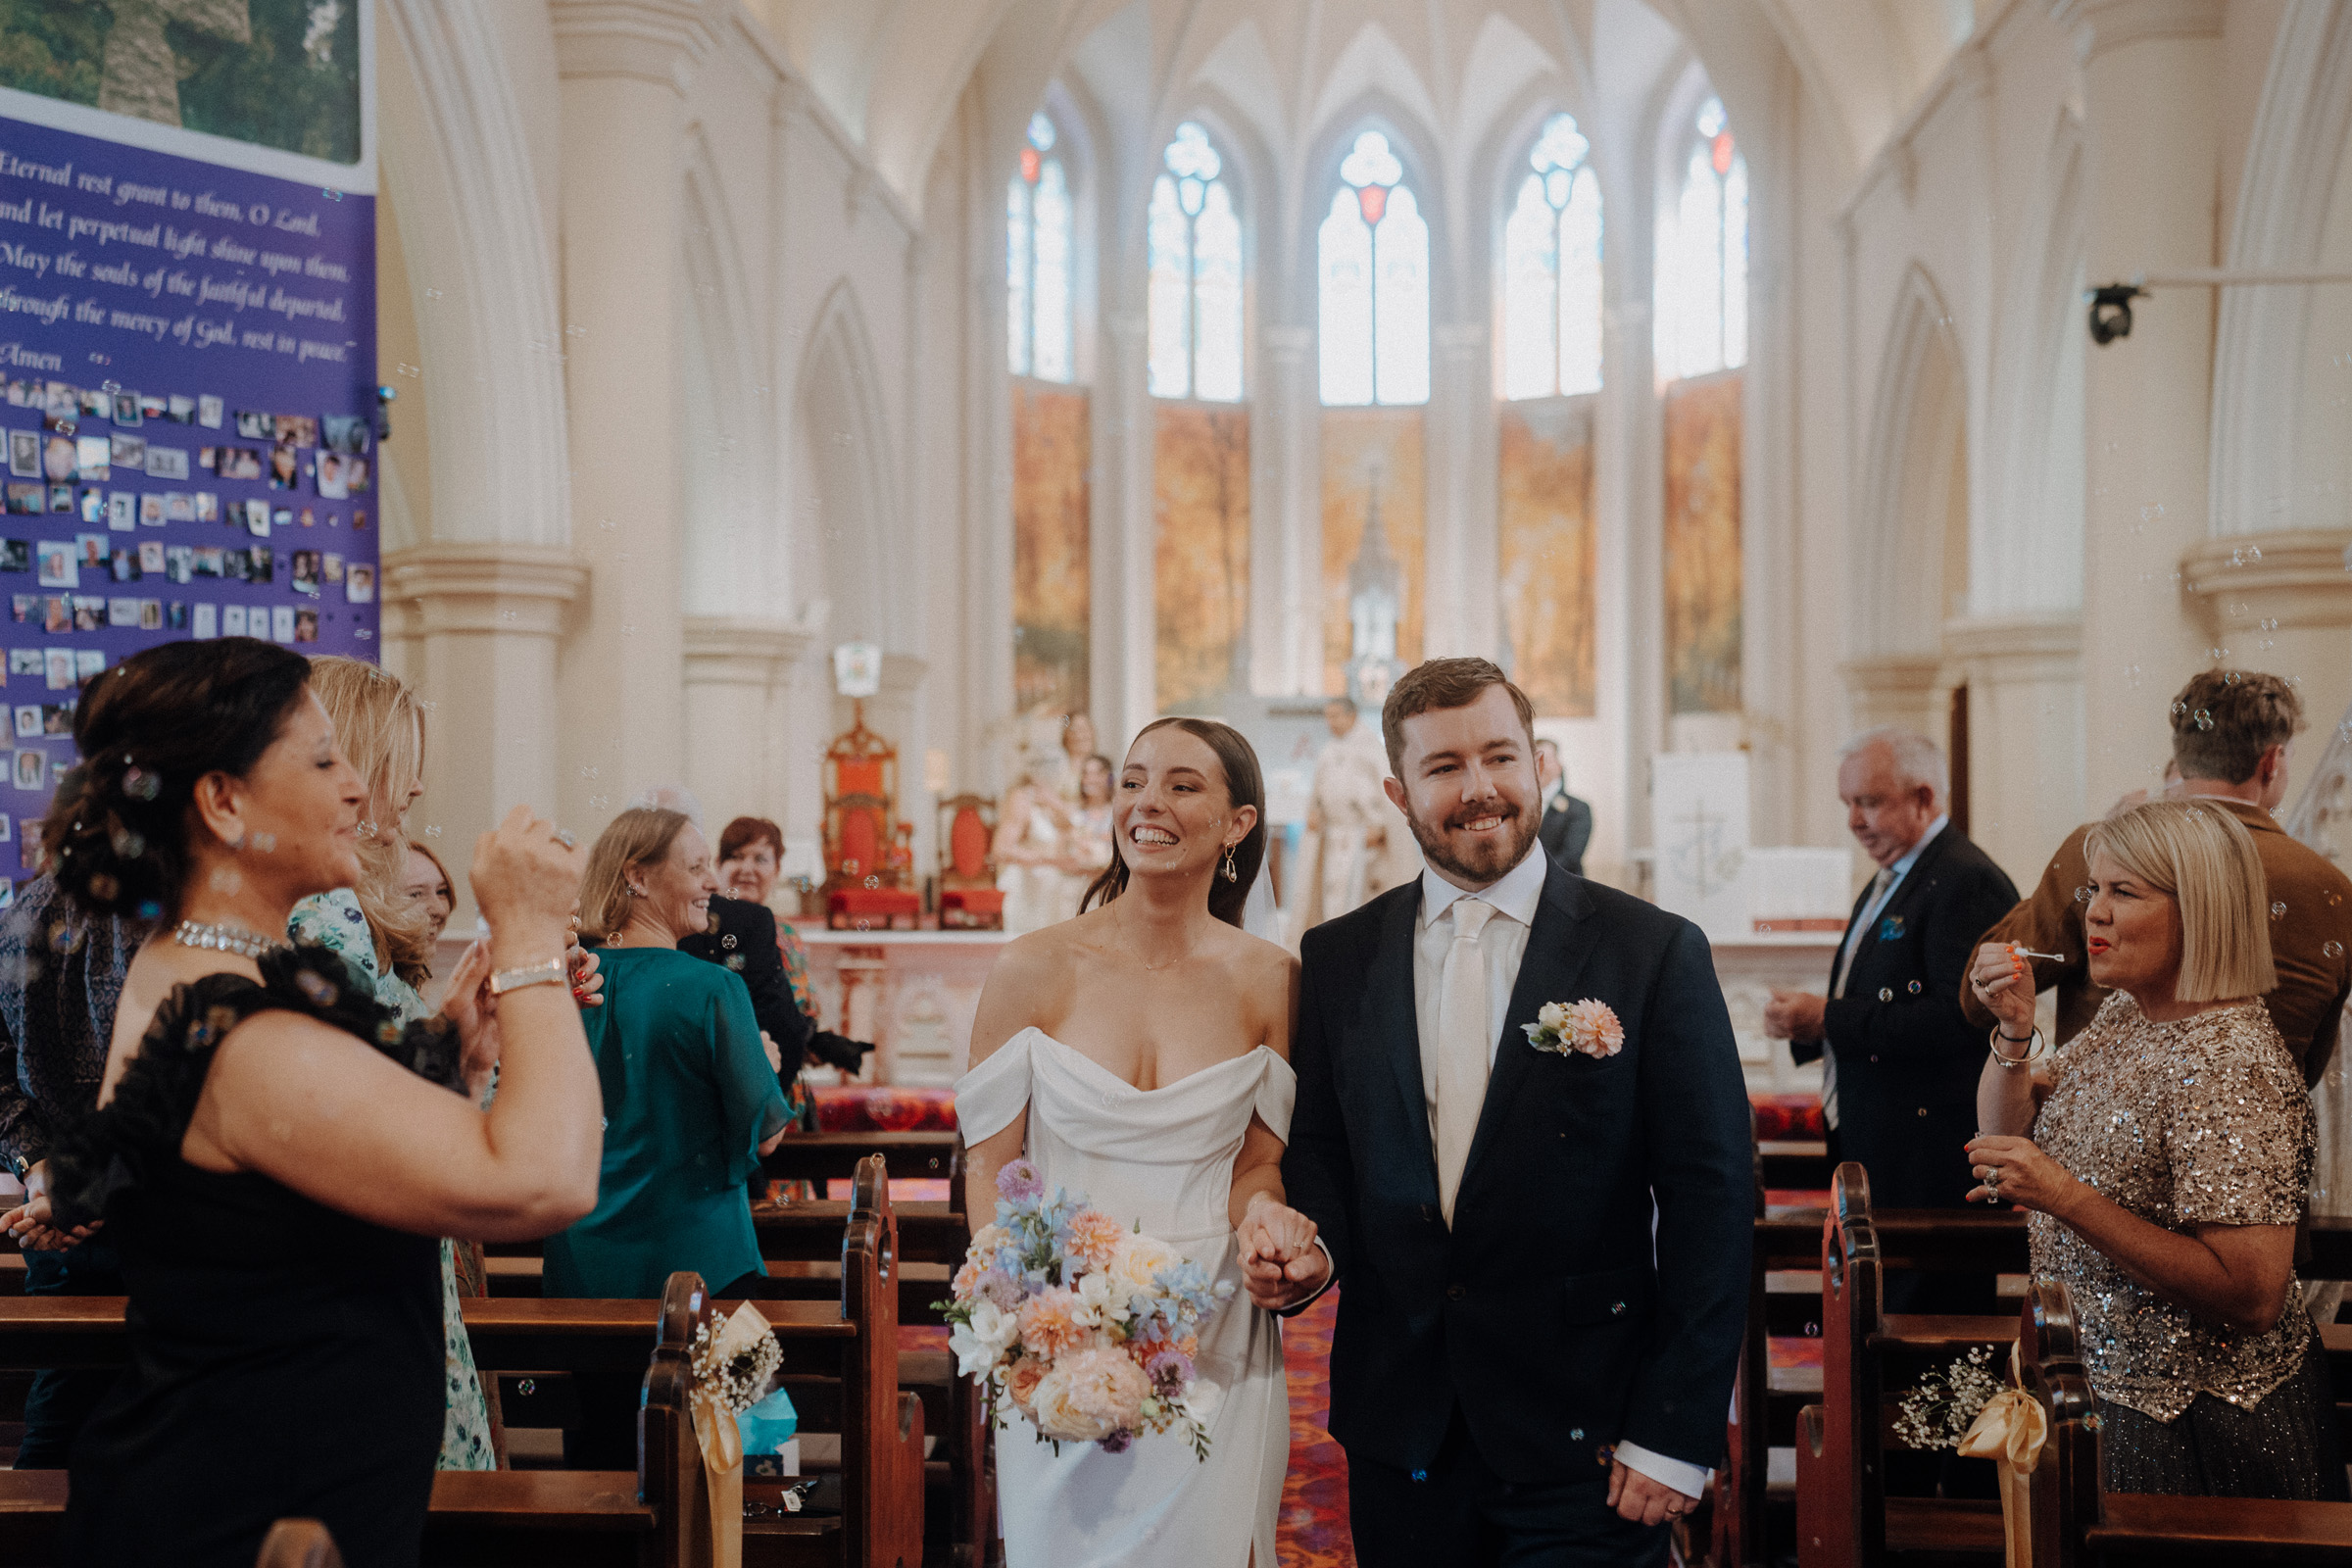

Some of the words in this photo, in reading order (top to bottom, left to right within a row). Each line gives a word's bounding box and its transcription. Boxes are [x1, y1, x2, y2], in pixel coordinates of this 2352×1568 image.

[0, 150, 73, 187] Eternal
[77, 172, 113, 195] rest
[113, 181, 168, 207] grant
[171, 190, 191, 210] to
[248, 204, 270, 226] O
[38, 201, 63, 229] let
[68, 215, 161, 246] perpetual
[164, 224, 207, 260] light
[209, 235, 258, 266] shine
[260, 251, 303, 277] upon
[0, 240, 51, 279] May
[55, 250, 87, 278] the
[90, 260, 139, 287] souls
[142, 267, 167, 299] of
[167, 270, 196, 297] the
[196, 274, 268, 313] faithful
[74, 296, 107, 325] the
[110, 310, 171, 342] mercy
[172, 315, 195, 346] of
[242, 330, 274, 352] rest
[275, 332, 297, 355] in
